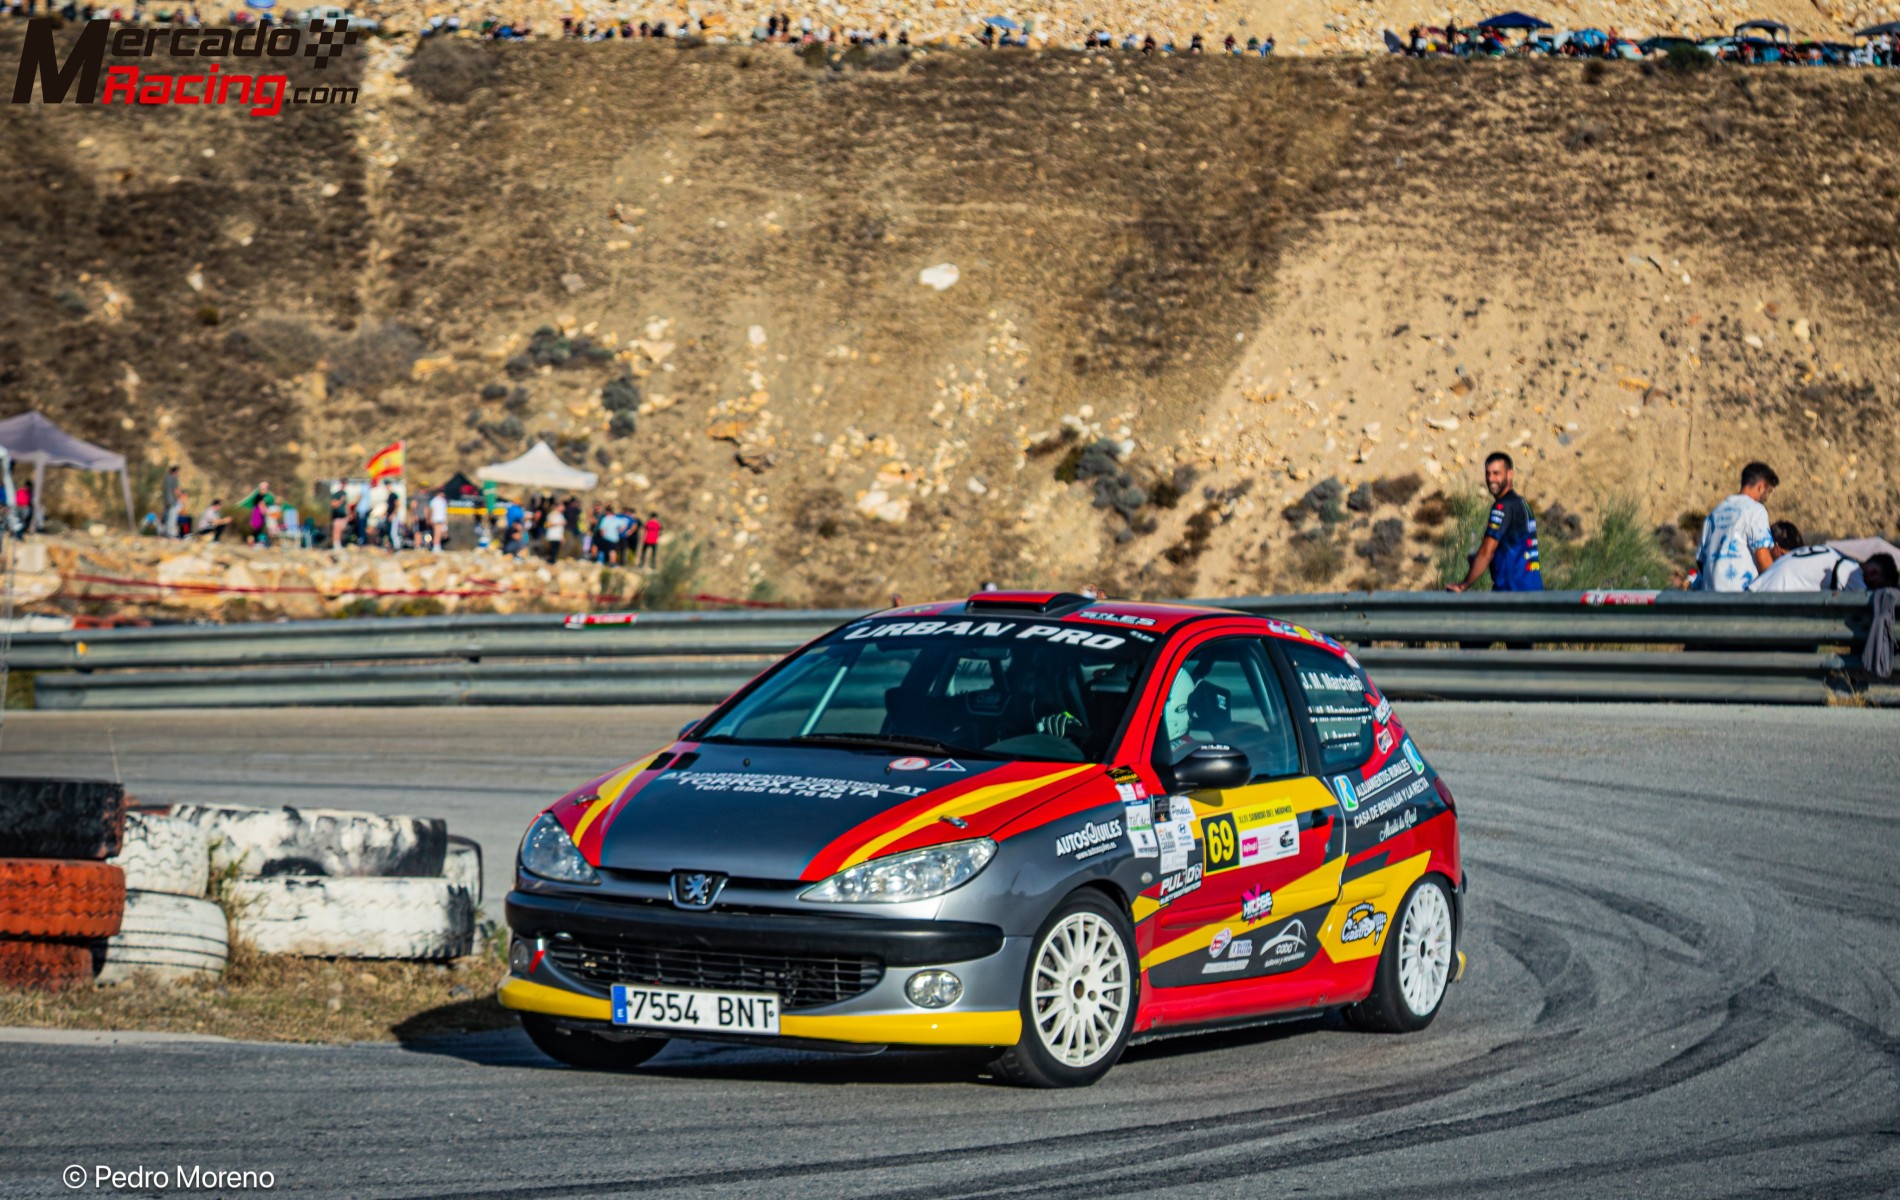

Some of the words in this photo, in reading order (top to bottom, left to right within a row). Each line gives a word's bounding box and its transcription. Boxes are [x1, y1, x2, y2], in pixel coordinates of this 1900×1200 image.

[844, 621, 1015, 640] URBAN
[1016, 624, 1126, 650] PRO
[1308, 672, 1324, 690] M.
[789, 781, 879, 798] COSTA
[1356, 770, 1391, 797] ALOJAMIENTOS
[1387, 758, 1411, 778] RURALES
[1354, 809, 1372, 829] CASA
[1369, 805, 1380, 820] DE
[1412, 777, 1430, 795] RECTA
[1056, 819, 1122, 857] AUTOSQUILES
[1207, 820, 1235, 864] 69
[617, 1009, 624, 1018] E
[633, 990, 699, 1024] 7554
[718, 997, 773, 1028] BNT
